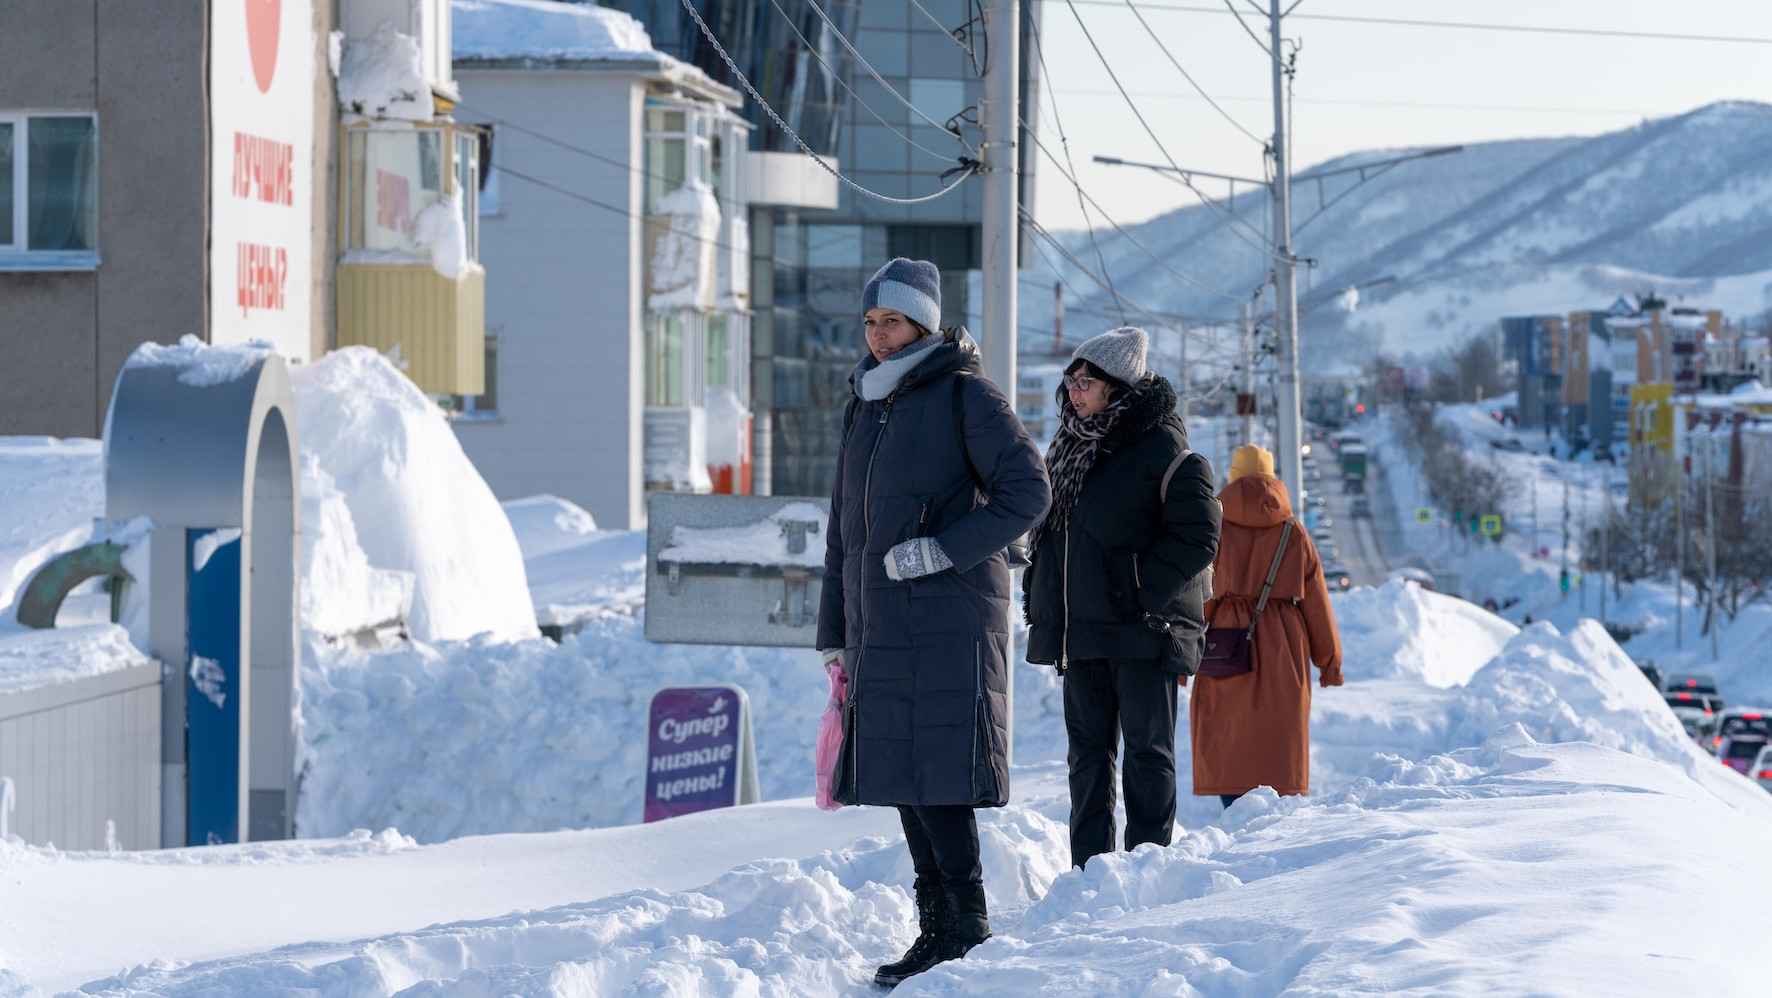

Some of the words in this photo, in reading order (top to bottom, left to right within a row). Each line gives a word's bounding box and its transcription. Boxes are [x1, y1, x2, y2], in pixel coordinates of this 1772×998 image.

[233, 131, 293, 207] ЛУЧШИЕ
[237, 241, 287, 319] ЦЕНЫ?
[658, 713, 730, 744] Супер
[651, 743, 733, 773] низкие
[656, 766, 726, 801] цены!
